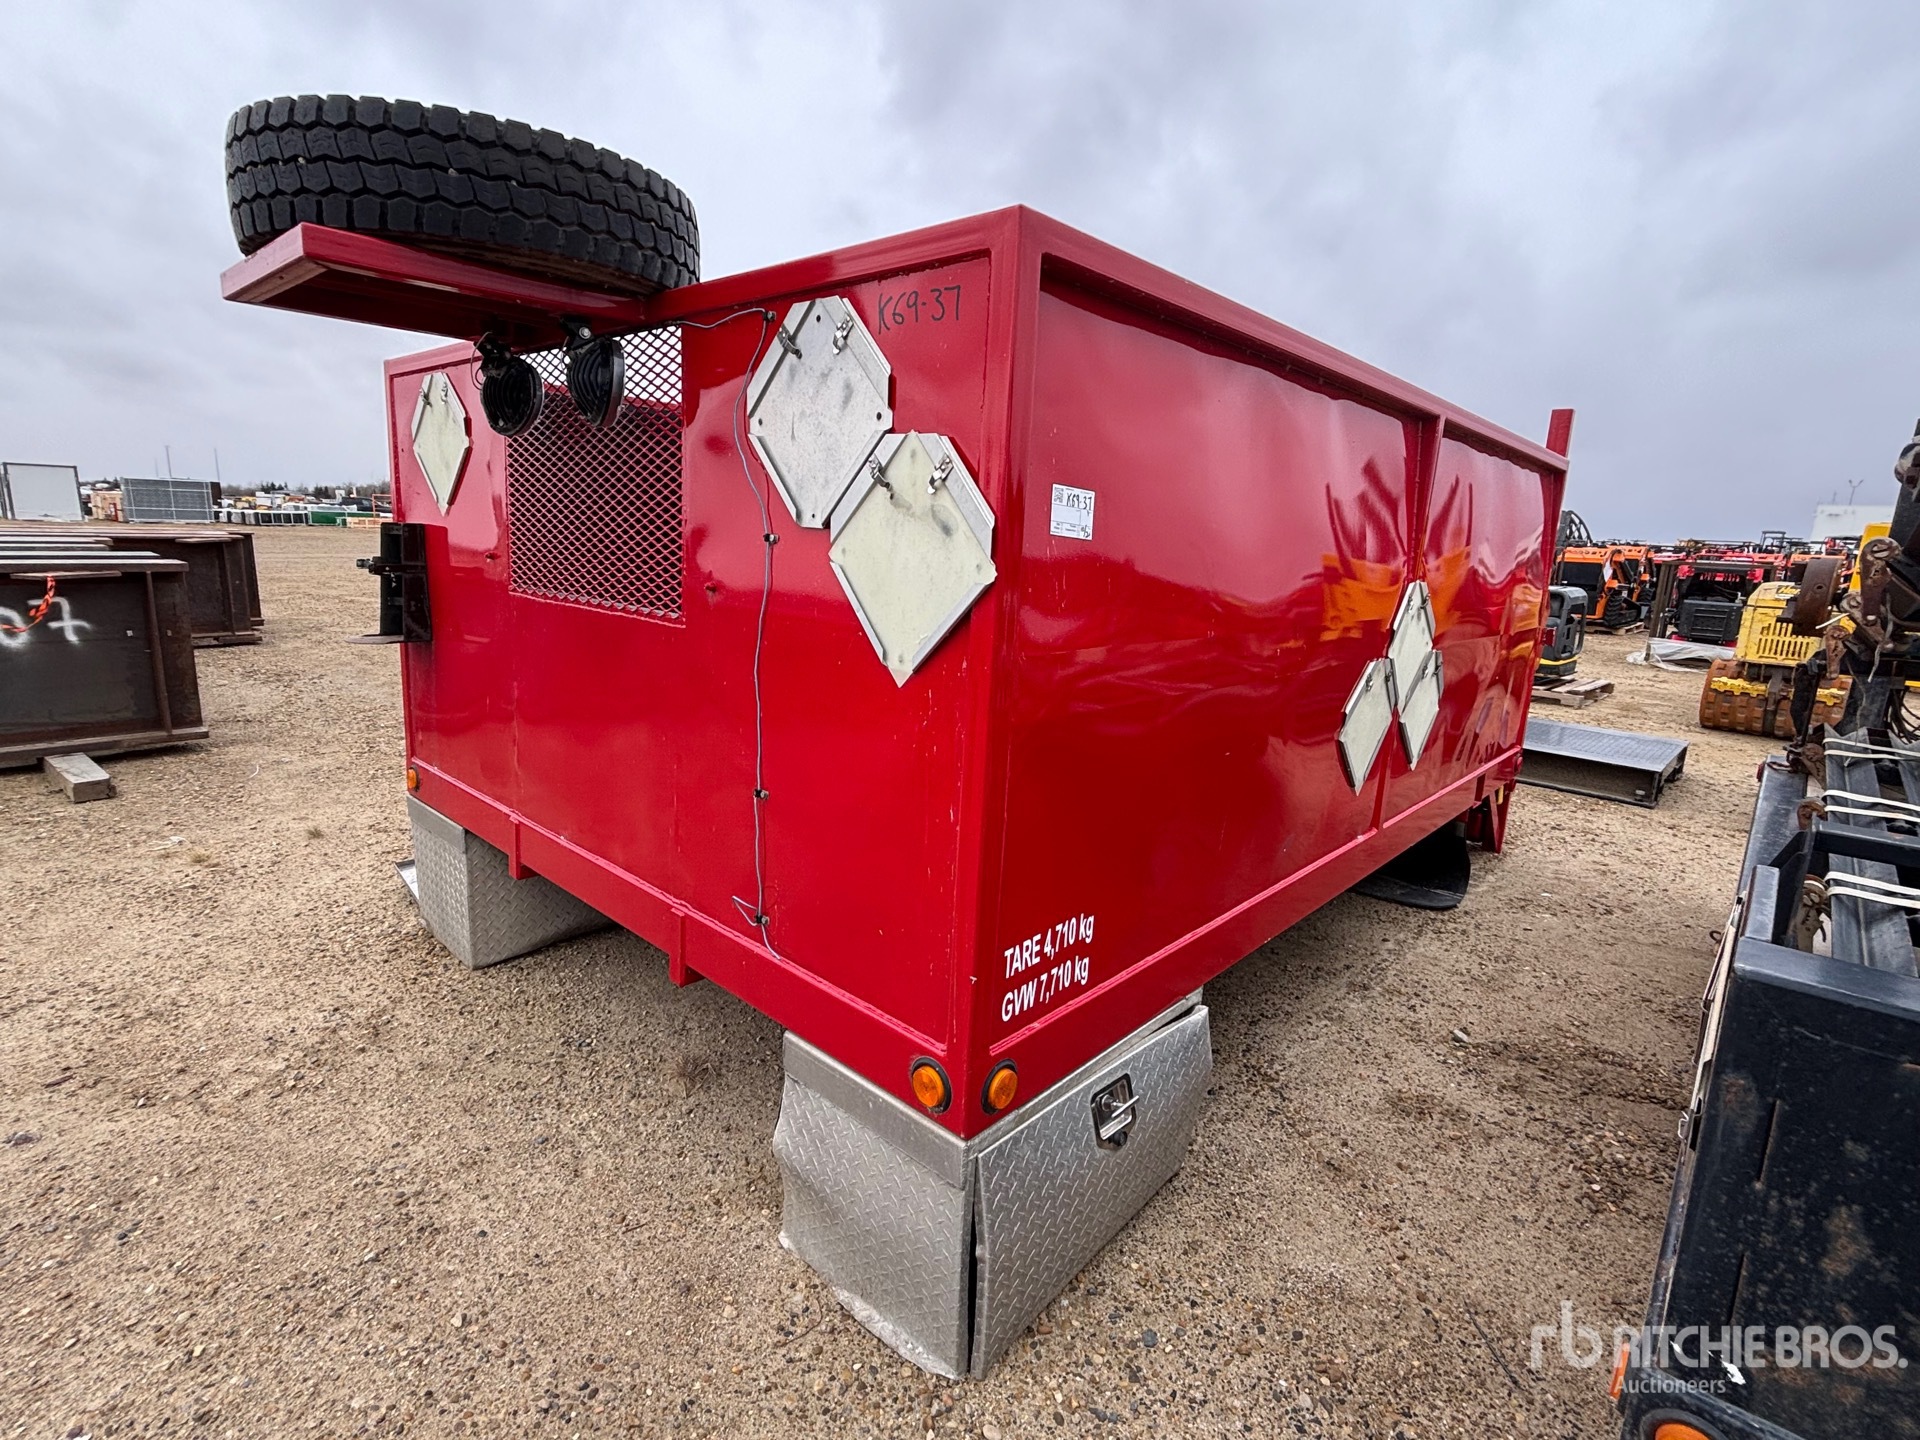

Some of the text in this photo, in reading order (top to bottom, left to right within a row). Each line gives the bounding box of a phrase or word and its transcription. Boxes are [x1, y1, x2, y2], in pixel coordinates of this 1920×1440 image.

[878, 285, 961, 334] K69-37
[1004, 913, 1095, 979] TARE 4,710 kg
[1002, 955, 1090, 1022] GVW 7,710 kg
